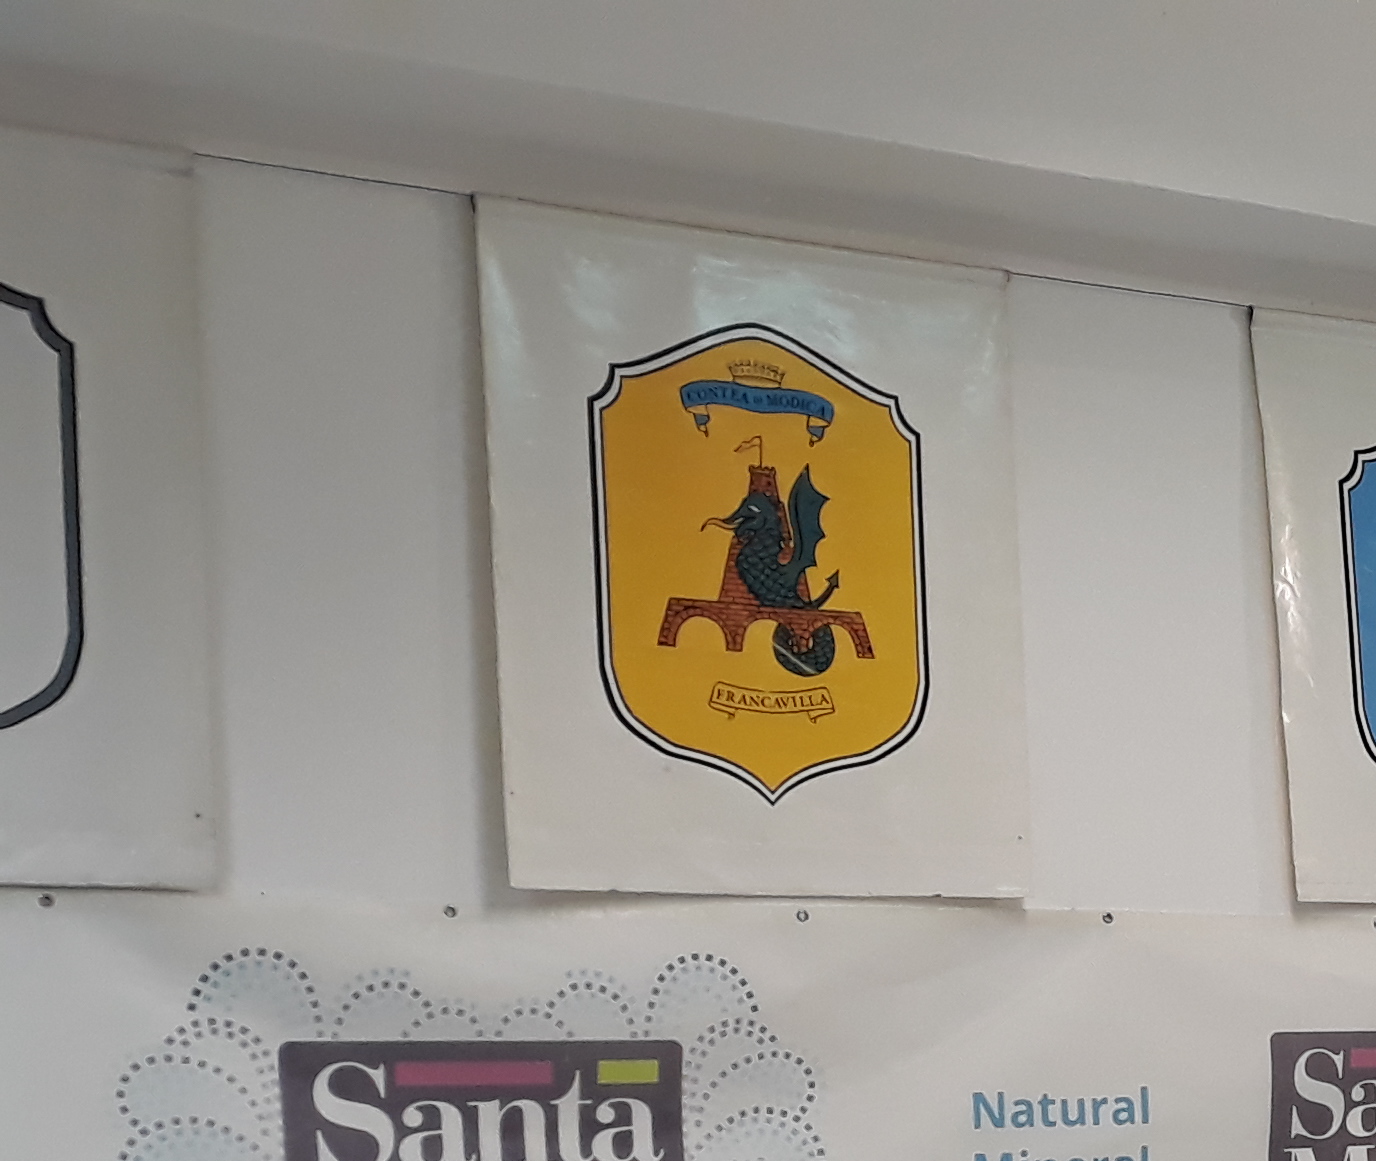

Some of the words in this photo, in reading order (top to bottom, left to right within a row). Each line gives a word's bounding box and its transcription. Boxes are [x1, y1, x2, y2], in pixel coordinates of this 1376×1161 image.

[765, 393, 826, 417] MODICA
[716, 688, 830, 709] FRANCAVILLA
[971, 1086, 1152, 1130] Natural
